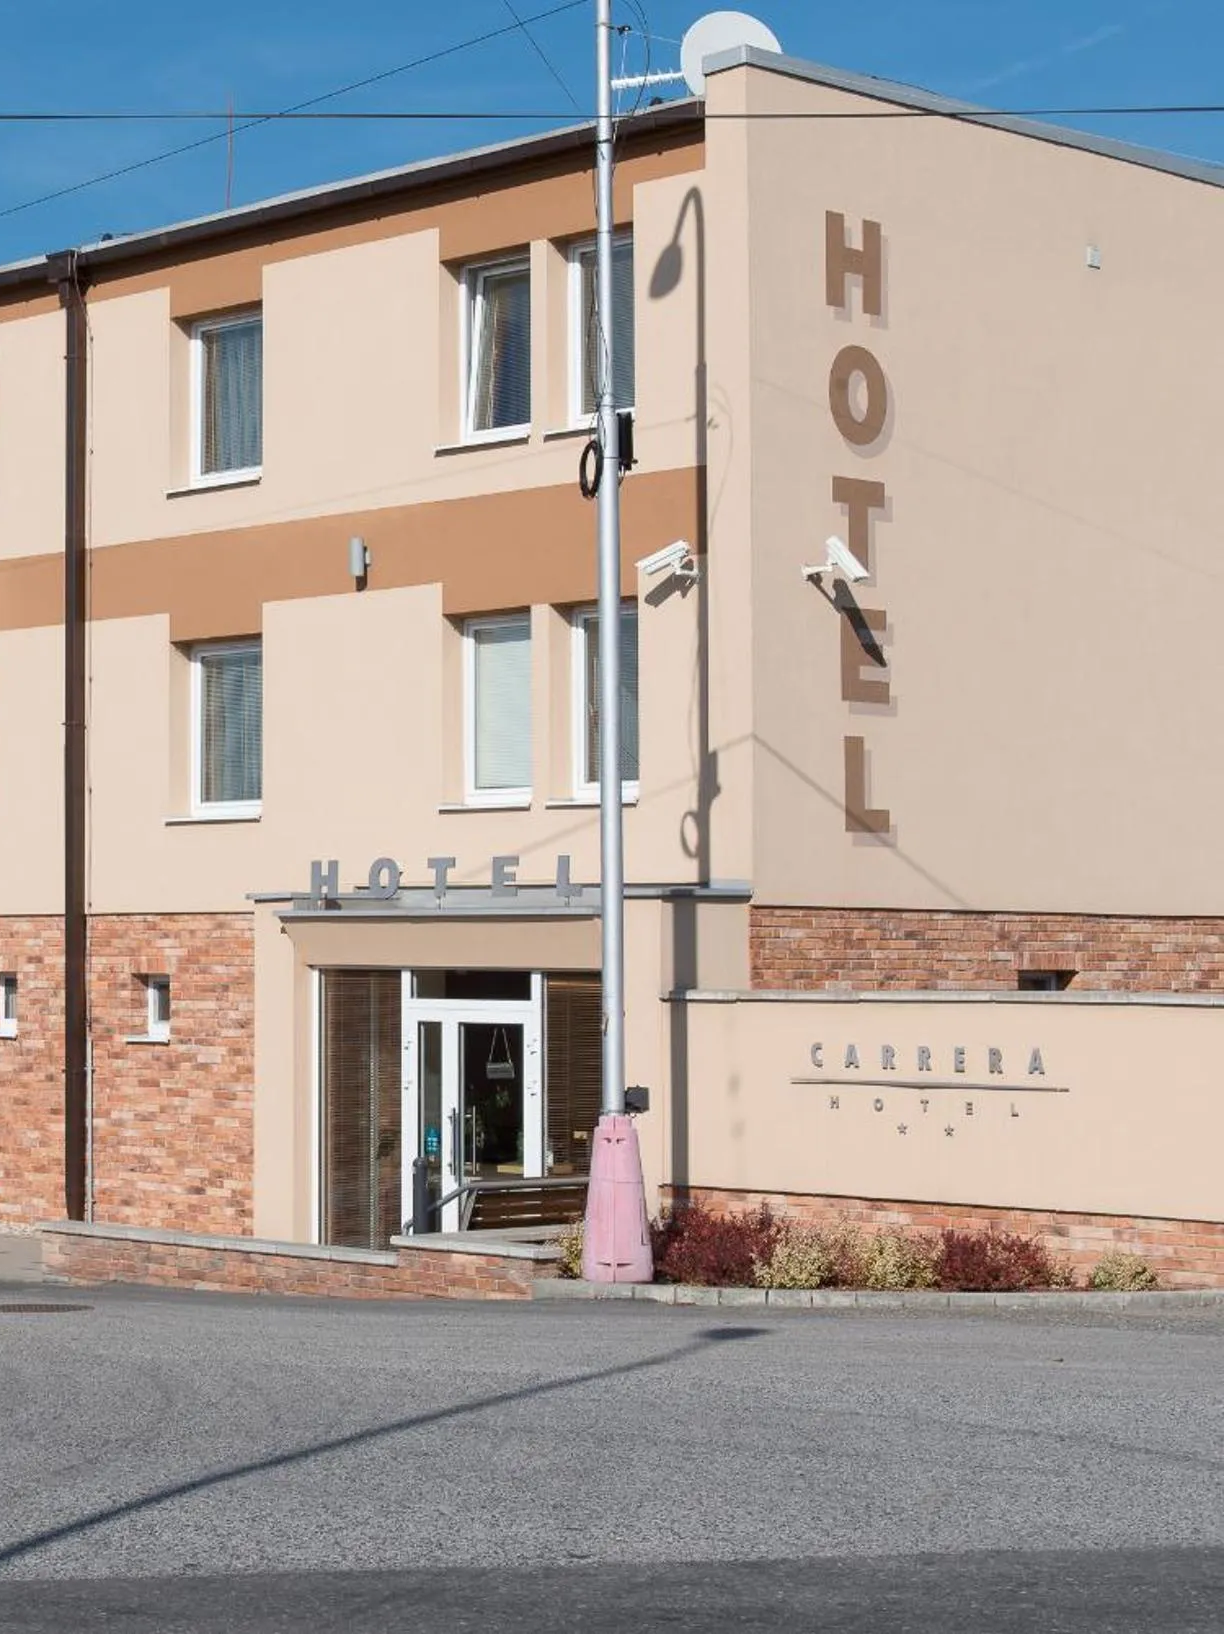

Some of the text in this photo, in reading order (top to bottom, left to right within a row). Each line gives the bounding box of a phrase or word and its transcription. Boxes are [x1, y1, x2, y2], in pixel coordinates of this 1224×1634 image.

[825, 209, 890, 833] HOTEL
[311, 855, 583, 899] HOTEL
[811, 1043, 1045, 1075] CARRERA
[830, 1096, 1019, 1117] HOTEL
